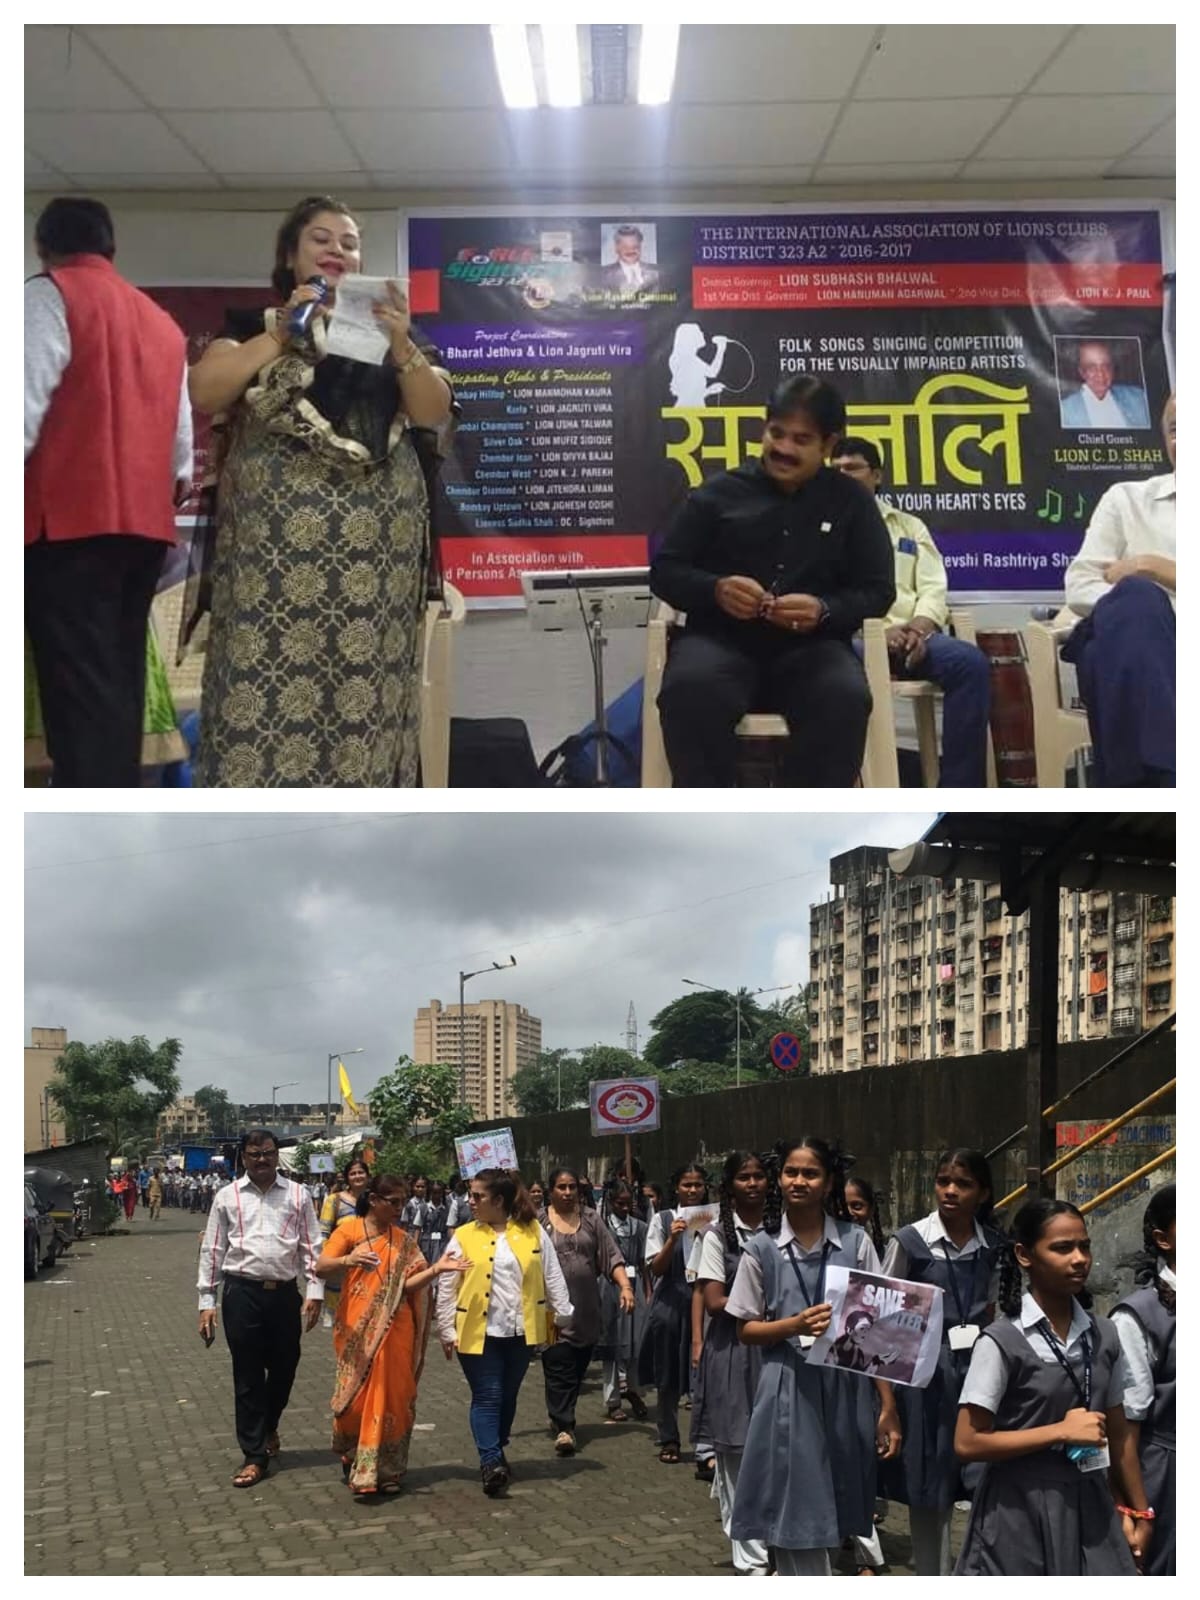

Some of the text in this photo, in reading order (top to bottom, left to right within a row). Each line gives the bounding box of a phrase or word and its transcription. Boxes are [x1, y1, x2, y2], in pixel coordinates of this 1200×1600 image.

[701, 222, 1108, 241] THE INTERNATIONAL ASSOCIATION OF LIONS CLUBS
[702, 243, 913, 260] DISTRICT 323 A2 2016-2017
[779, 273, 809, 287] LION
[812, 272, 874, 287] SUBHASH
[877, 271, 937, 285] BHALWAL
[719, 291, 740, 301] Vice
[817, 289, 841, 301] LION
[842, 288, 895, 300] HANUMAN
[1076, 287, 1100, 298] LION
[1127, 288, 1152, 299] PAUL
[475, 330, 509, 343] Project
[778, 335, 1024, 353] FOLK SONGS SINGING COMPETITION
[447, 346, 483, 359] Bharat
[486, 345, 523, 359] Jethva
[526, 345, 536, 357] &
[539, 345, 564, 358] Lion
[566, 344, 606, 360] Jagruti
[608, 344, 632, 357] Vira
[780, 354, 1026, 372] FOR THE VISUALLY IMPAIRED ARTISTS
[450, 373, 499, 387] ticipating
[503, 369, 536, 385] Clubs
[552, 369, 612, 382] Presidents
[513, 388, 533, 399] LION
[536, 403, 555, 414] LION
[557, 403, 591, 413] JAGRUTI
[593, 402, 613, 412] VIRA
[535, 419, 554, 430] LION
[580, 418, 613, 429] TALWAR
[531, 435, 551, 446] LION
[552, 434, 578, 446] MUFIZ
[1077, 433, 1134, 445] Chief Guest
[541, 451, 560, 462] LION
[562, 451, 587, 462] DIVYA
[588, 450, 613, 461] BAJAJ
[1054, 448, 1089, 463] LION
[1123, 448, 1163, 463] SHAH
[540, 467, 559, 478] LION
[581, 467, 614, 478] PAREKH
[525, 484, 545, 495] LION
[530, 500, 550, 511] LION
[896, 492, 932, 511] YOUR
[935, 492, 992, 511] HEART'S
[994, 491, 1027, 511] EYES
[471, 550, 584, 565] In Association with
[944, 552, 979, 568] evshi
[984, 552, 1048, 571] Rashtriya
[456, 567, 505, 581] Persons
[862, 1283, 907, 1313] SAVE
